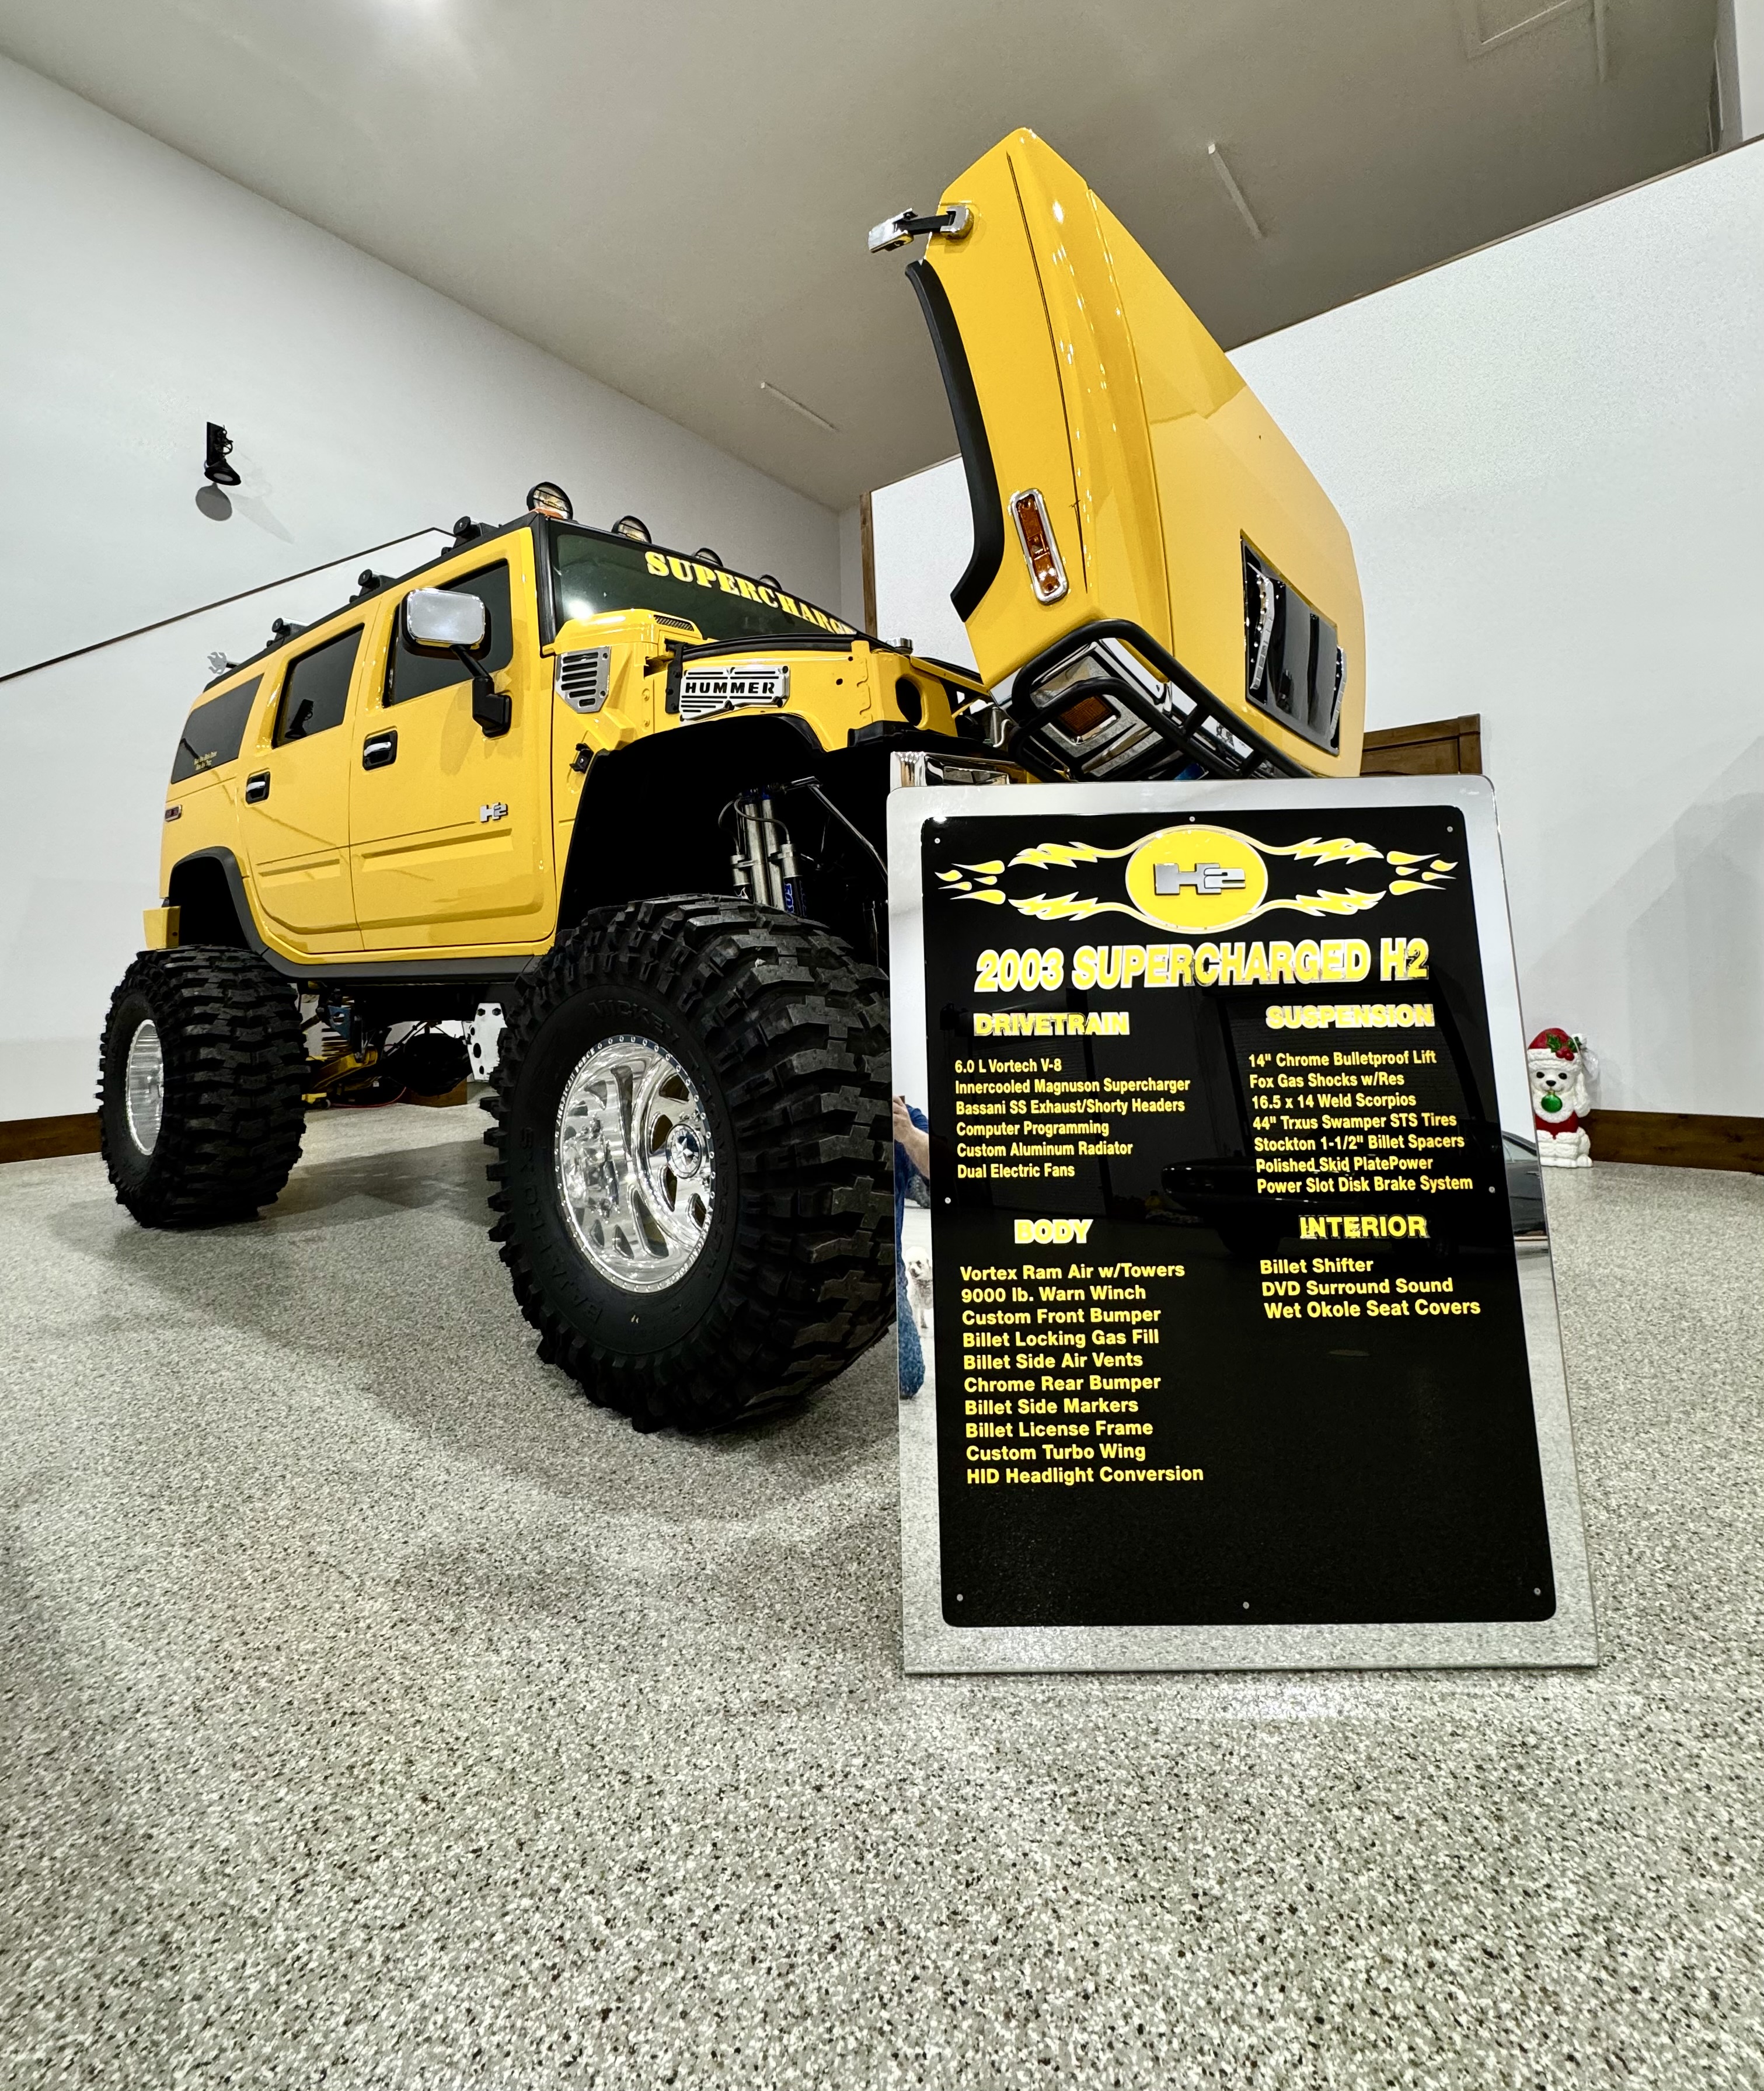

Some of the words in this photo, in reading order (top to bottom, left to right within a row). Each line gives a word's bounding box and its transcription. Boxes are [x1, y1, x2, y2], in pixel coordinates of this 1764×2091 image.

[685, 682, 775, 694] HUMMER
[480, 802, 508, 823] H2
[1153, 862, 1246, 896] H2
[973, 949, 1064, 992] 2003
[1072, 939, 1372, 989] SUPERCHARGED
[1380, 938, 1429, 981] H2
[973, 1012, 1131, 1036] DRIVETRAIN
[1266, 1003, 1436, 1029] SUSPENSION
[955, 1060, 974, 1073] 6.0
[979, 1060, 986, 1072] L
[989, 1060, 1037, 1072] Vortech
[1041, 1058, 1062, 1071] V-8
[1249, 1054, 1271, 1067] 14"
[1276, 1053, 1329, 1067] Chrome
[1333, 1051, 1409, 1068] Bulletproof
[1413, 1050, 1437, 1064] Lift
[956, 1079, 1030, 1094] Innercooled
[1034, 1079, 1100, 1095] Magnuson
[1104, 1078, 1190, 1094] Supercharger
[1250, 1075, 1274, 1088] Fox
[1278, 1074, 1304, 1088] Gas
[1308, 1073, 1358, 1087] Shocks
[1361, 1072, 1404, 1086] w/Res
[956, 1102, 1006, 1114] Bassani
[1010, 1100, 1027, 1114] SS
[1031, 1099, 1128, 1115] Exhaust/Shorty
[1132, 1098, 1185, 1112] Headers
[1252, 1095, 1281, 1109] 16.5
[1285, 1098, 1293, 1108] x
[1298, 1095, 1314, 1108] 14
[1317, 1093, 1351, 1107] Weld
[1356, 1093, 1416, 1109] Scorpios
[957, 1122, 1020, 1138] Computer
[1024, 1120, 1109, 1137] Programming
[1253, 1116, 1276, 1130] 44"
[1280, 1116, 1318, 1130] Trxus
[1322, 1115, 1386, 1131] Swamper
[1390, 1113, 1418, 1127] STS
[1421, 1113, 1456, 1126] Tires
[957, 1143, 1006, 1157] Custom
[1010, 1142, 1074, 1156] Aluminum
[1079, 1141, 1133, 1155] Radiator
[1254, 1137, 1316, 1151] Stockton
[1321, 1135, 1363, 1149] 1-1/2"
[1368, 1135, 1404, 1149] Billet
[1409, 1134, 1465, 1151] Spacers
[958, 1164, 986, 1178] Dual
[991, 1163, 1040, 1177] Electric
[1044, 1163, 1075, 1177] Fans
[1256, 1158, 1316, 1172] Polished
[1320, 1157, 1350, 1173] Skid
[1354, 1156, 1433, 1170] PlatePower
[1257, 1179, 1302, 1193] Power
[1306, 1177, 1334, 1193] Slot
[1338, 1177, 1370, 1191] Disk
[1374, 1176, 1416, 1191] Brake
[1420, 1175, 1473, 1193] System
[1014, 1219, 1094, 1244] BODY
[1299, 1215, 1430, 1239] INTERIOR
[960, 1266, 1017, 1281] Vortex
[1023, 1265, 1062, 1279] Ram
[1068, 1264, 1093, 1278] Air
[1098, 1263, 1185, 1278] w/Towers
[1260, 1259, 1307, 1274] Billet
[1313, 1258, 1373, 1273] Shifter
[961, 1288, 1006, 1302] 9000
[1012, 1287, 1033, 1301] lb.
[1038, 1287, 1085, 1301] Warn
[1090, 1285, 1146, 1300] Winch
[1262, 1281, 1300, 1296] DVD
[1306, 1279, 1390, 1295] Surround
[1396, 1277, 1453, 1293] Sound
[963, 1311, 1031, 1325] Custom
[1037, 1309, 1085, 1323] Front
[1090, 1308, 1161, 1325] Bumper
[1264, 1302, 1302, 1318] Wet
[1307, 1301, 1360, 1318] Okole
[1366, 1300, 1410, 1316] Seat
[1415, 1299, 1480, 1315] Covers
[963, 1332, 1010, 1347] Billet
[1016, 1331, 1085, 1348] Locking
[1092, 1330, 1126, 1344] Gas
[1132, 1329, 1159, 1344] Fill
[964, 1355, 1010, 1369] Billet
[1016, 1354, 1055, 1368] Side
[1061, 1353, 1087, 1368] Air
[1092, 1353, 1143, 1367] Vents
[964, 1377, 1035, 1392] Chrome
[1041, 1376, 1083, 1390] Rear
[1090, 1375, 1161, 1392] Bumper
[965, 1400, 1012, 1414] Billet
[1018, 1399, 1057, 1414] Side
[1064, 1398, 1138, 1413] Markers
[966, 1423, 1013, 1438] Billet
[1019, 1422, 1089, 1437] License
[1096, 1420, 1153, 1435] Frame
[967, 1445, 1036, 1461] Custom
[1042, 1444, 1094, 1459] Turbo
[1099, 1444, 1145, 1461] Wing
[967, 1469, 999, 1484] HID
[1006, 1467, 1094, 1486] Headlight
[1100, 1466, 1203, 1482] Conversion
